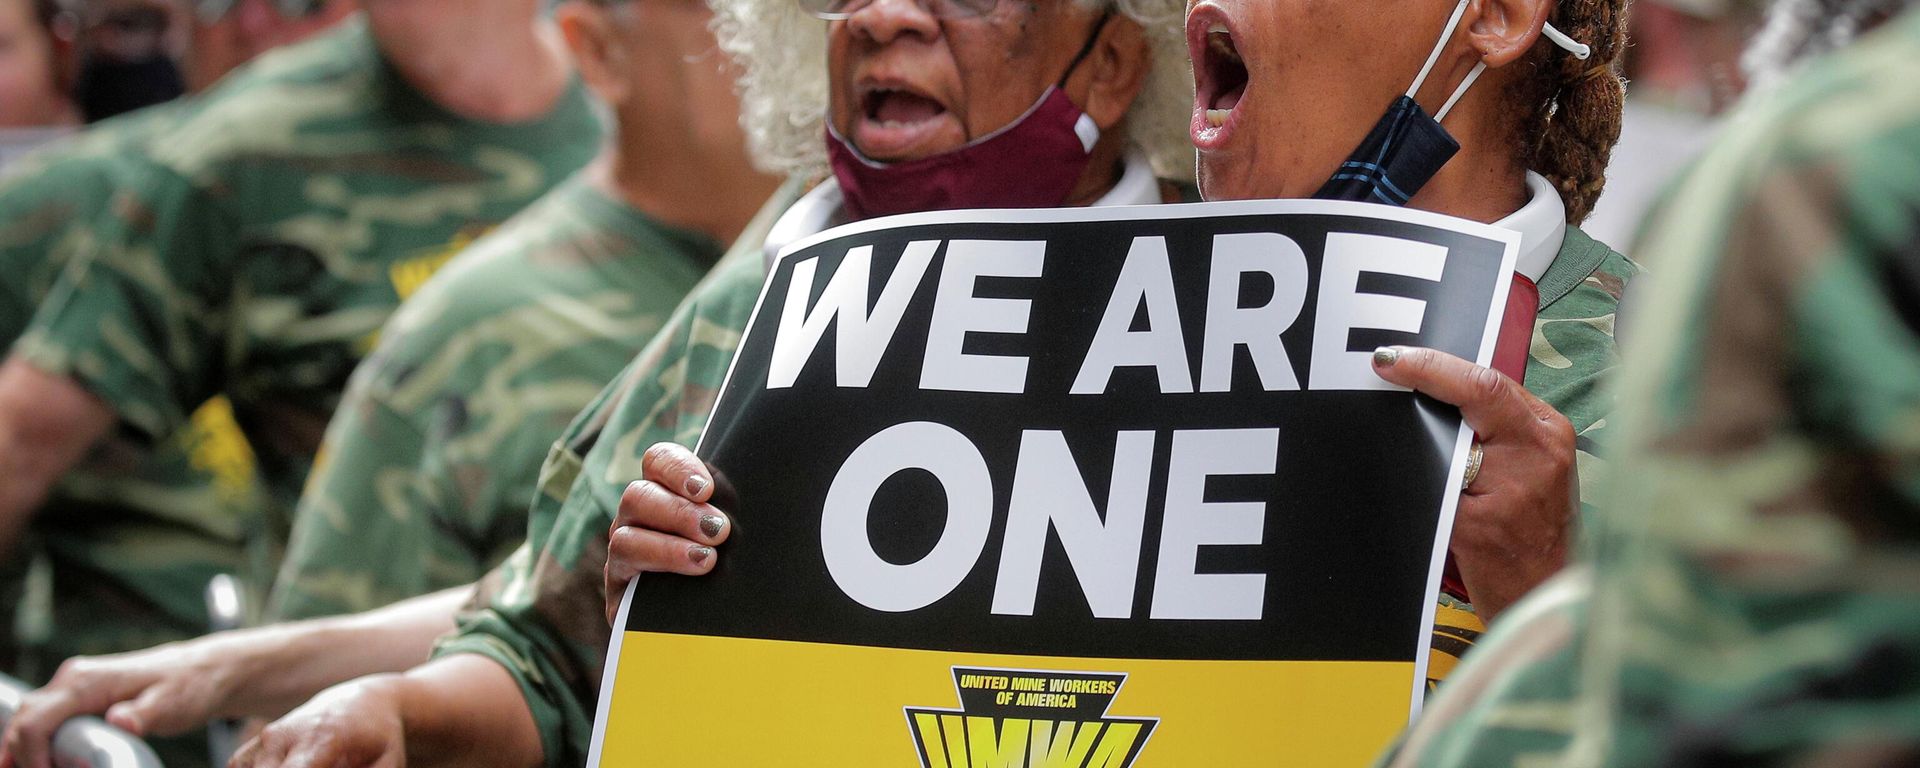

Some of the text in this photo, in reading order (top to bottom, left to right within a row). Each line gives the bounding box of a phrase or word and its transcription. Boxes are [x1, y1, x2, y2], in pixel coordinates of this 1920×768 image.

[766, 231, 1449, 394] WE ARE
[820, 420, 1280, 620] ONE
[961, 674, 1116, 694] UNITED MINE WORKERS
[996, 692, 1077, 708] OF AMERICA
